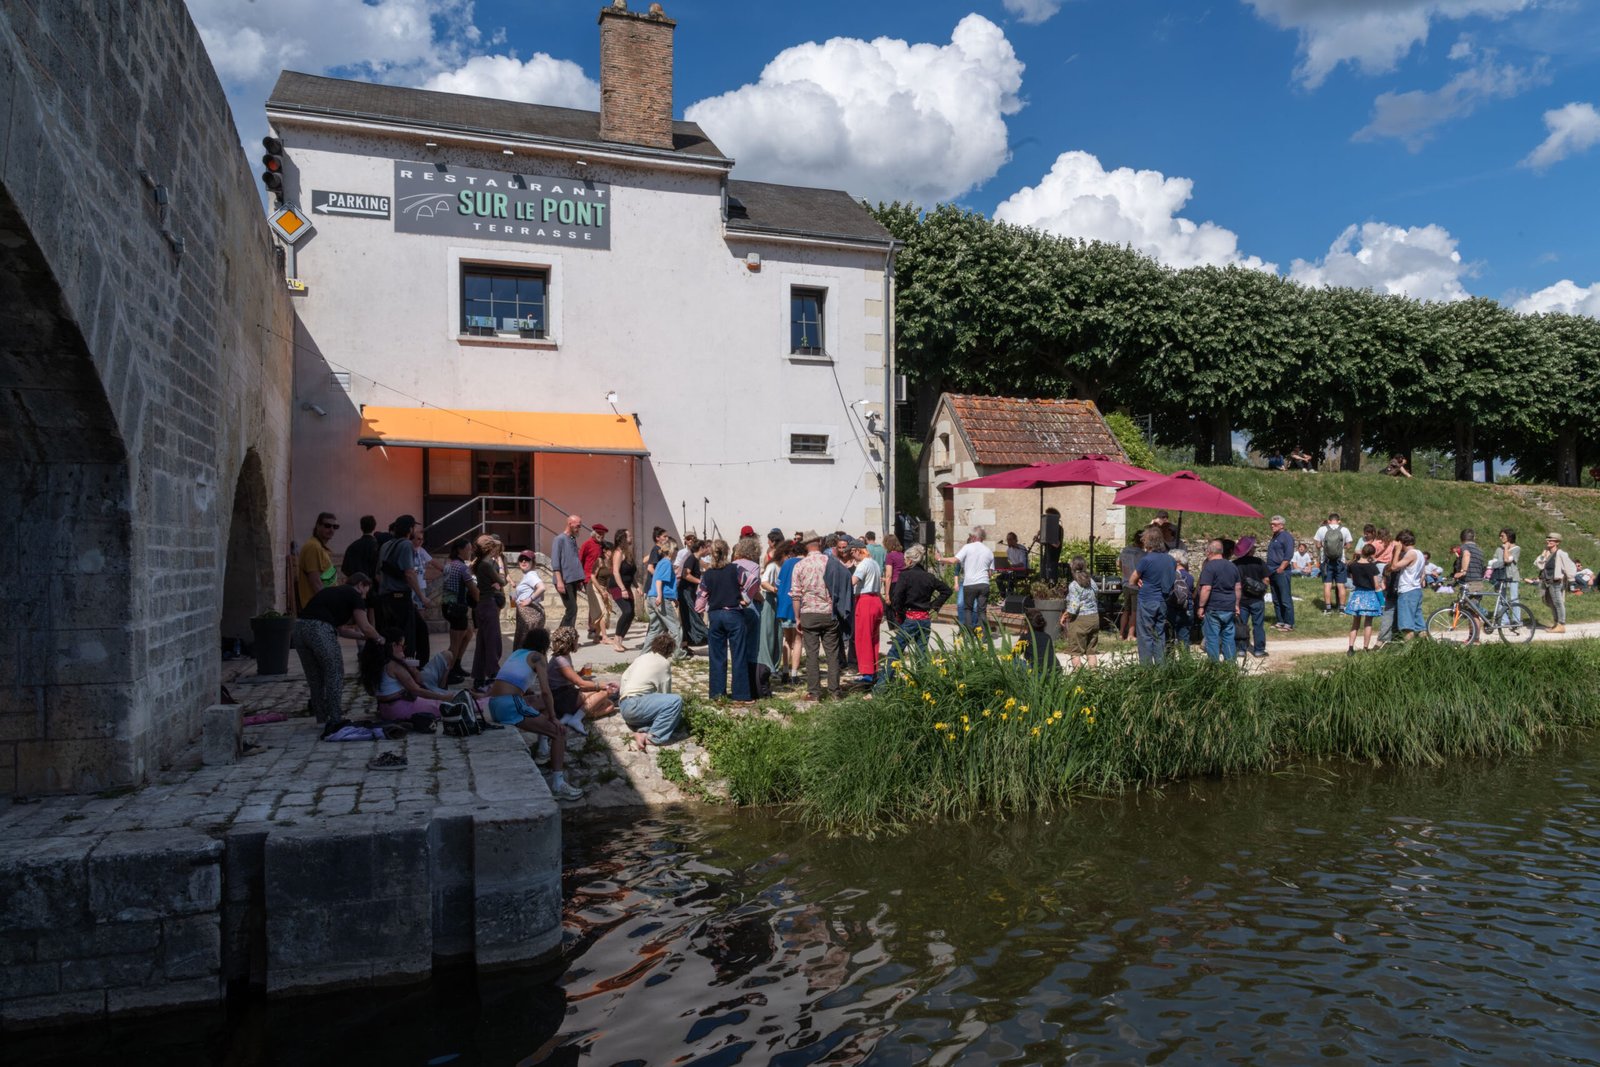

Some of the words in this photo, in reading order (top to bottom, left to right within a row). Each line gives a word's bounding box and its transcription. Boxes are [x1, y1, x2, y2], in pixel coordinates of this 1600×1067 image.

[400, 169, 606, 198] RESTAURANT
[328, 193, 388, 211] PARKING
[459, 189, 508, 218] SUR
[516, 202, 535, 220] LE
[542, 197, 606, 227] PONT
[473, 222, 592, 241] TERRASSE
